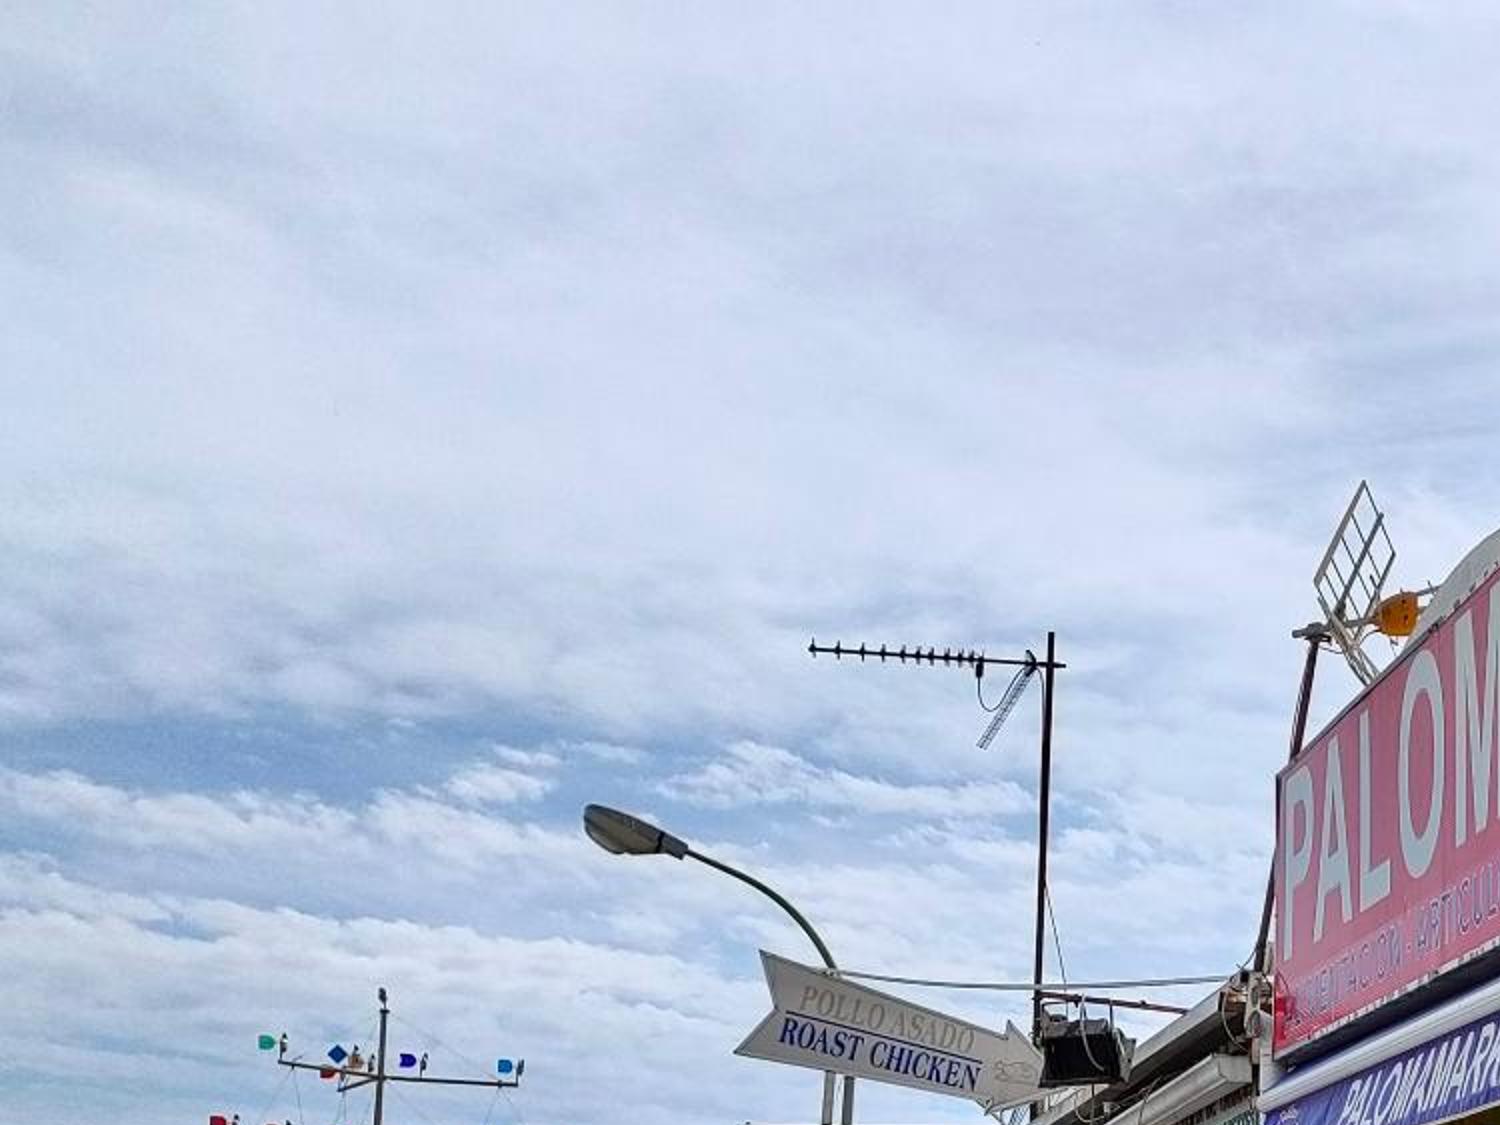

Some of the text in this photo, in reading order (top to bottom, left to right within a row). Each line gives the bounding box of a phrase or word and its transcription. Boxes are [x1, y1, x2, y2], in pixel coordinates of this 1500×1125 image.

[779, 1017, 982, 1093] ROAST CHICKEN
[800, 984, 976, 1054] POLLO ASADO
